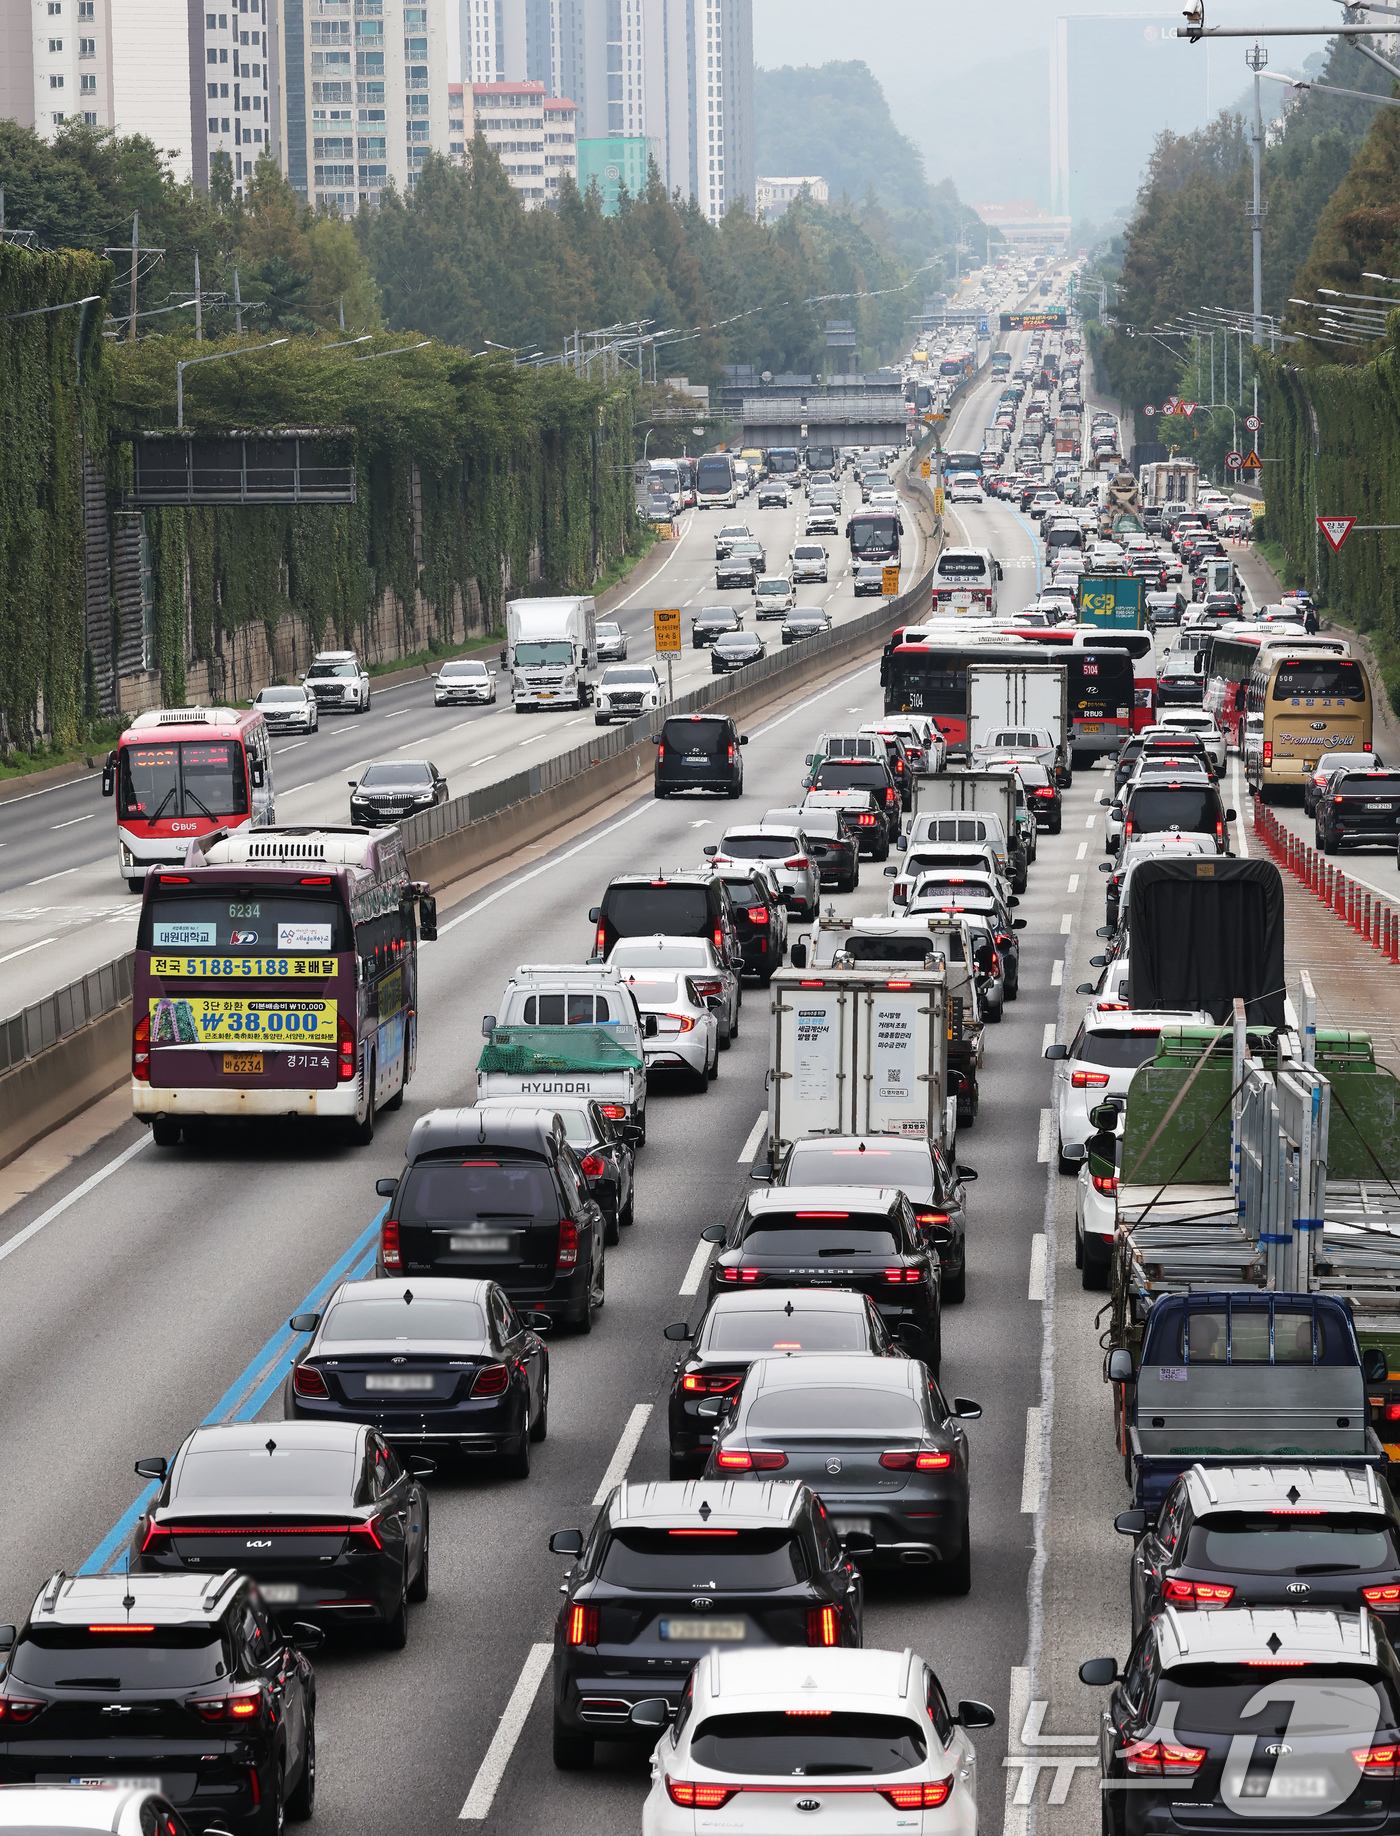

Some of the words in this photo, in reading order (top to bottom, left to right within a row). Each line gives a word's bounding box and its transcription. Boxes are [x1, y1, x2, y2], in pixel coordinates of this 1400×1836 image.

[1083, 665, 1099, 675] 5104
[910, 693, 923, 708] 5104
[1291, 698, 1346, 707] 중앙고속
[229, 904, 260, 918] 6234
[160, 932, 209, 943] 대원대학교
[155, 959, 181, 973] 전국
[186, 959, 289, 975] 5188-5188
[293, 960, 335, 974] 꽃배달
[202, 1001, 220, 1011] 3단
[223, 1001, 243, 1011] 화환
[797, 1025, 830, 1033] 세금계산서
[225, 1061, 232, 1069] 바
[233, 1060, 262, 1072] 6234
[287, 1055, 331, 1068] 경기고속
[521, 1082, 590, 1093] HYUNDAI
[246, 1540, 272, 1548] KIA
